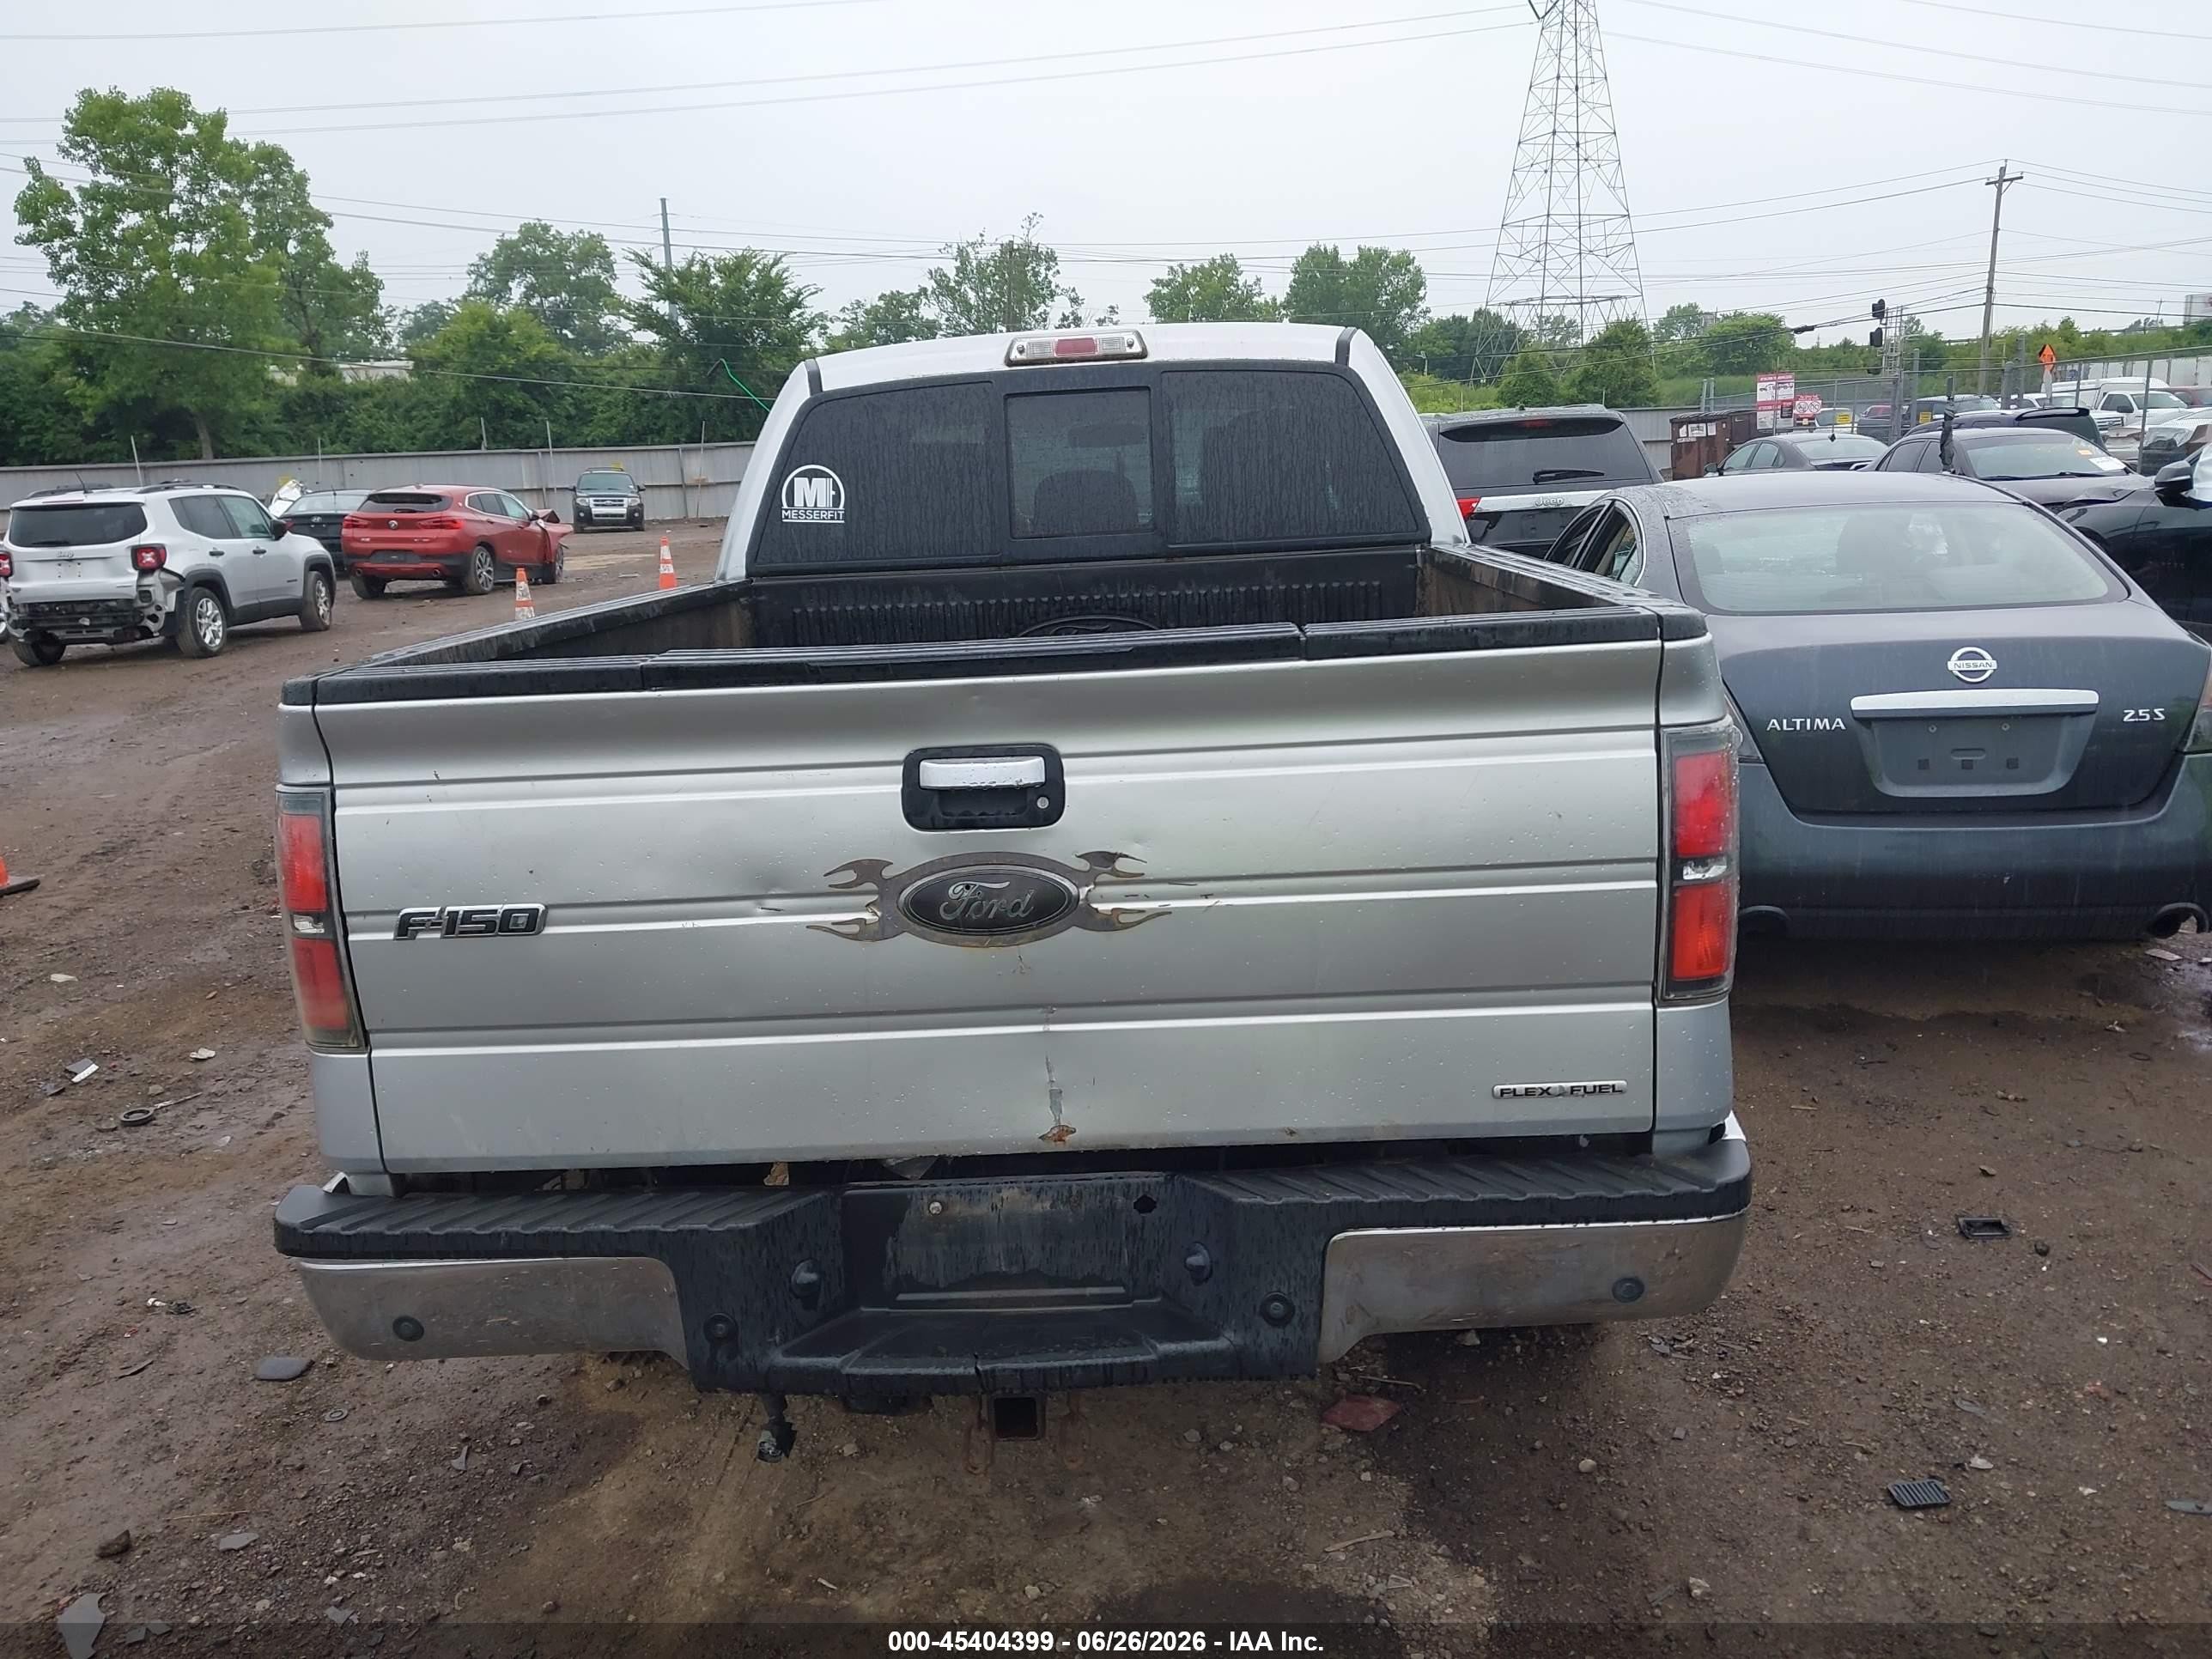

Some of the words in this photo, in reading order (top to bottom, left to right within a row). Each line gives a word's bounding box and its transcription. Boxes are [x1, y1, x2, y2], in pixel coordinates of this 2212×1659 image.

[1535, 496, 1565, 507] Jeep
[781, 509, 845, 520] MESSERFIT
[1954, 660, 1993, 669] NISSAN
[1766, 717, 1847, 732] ALTIMA
[939, 881, 1035, 921] Ford
[1499, 1085, 1553, 1097] FLEX
[1570, 1084, 1624, 1095] FUEL
